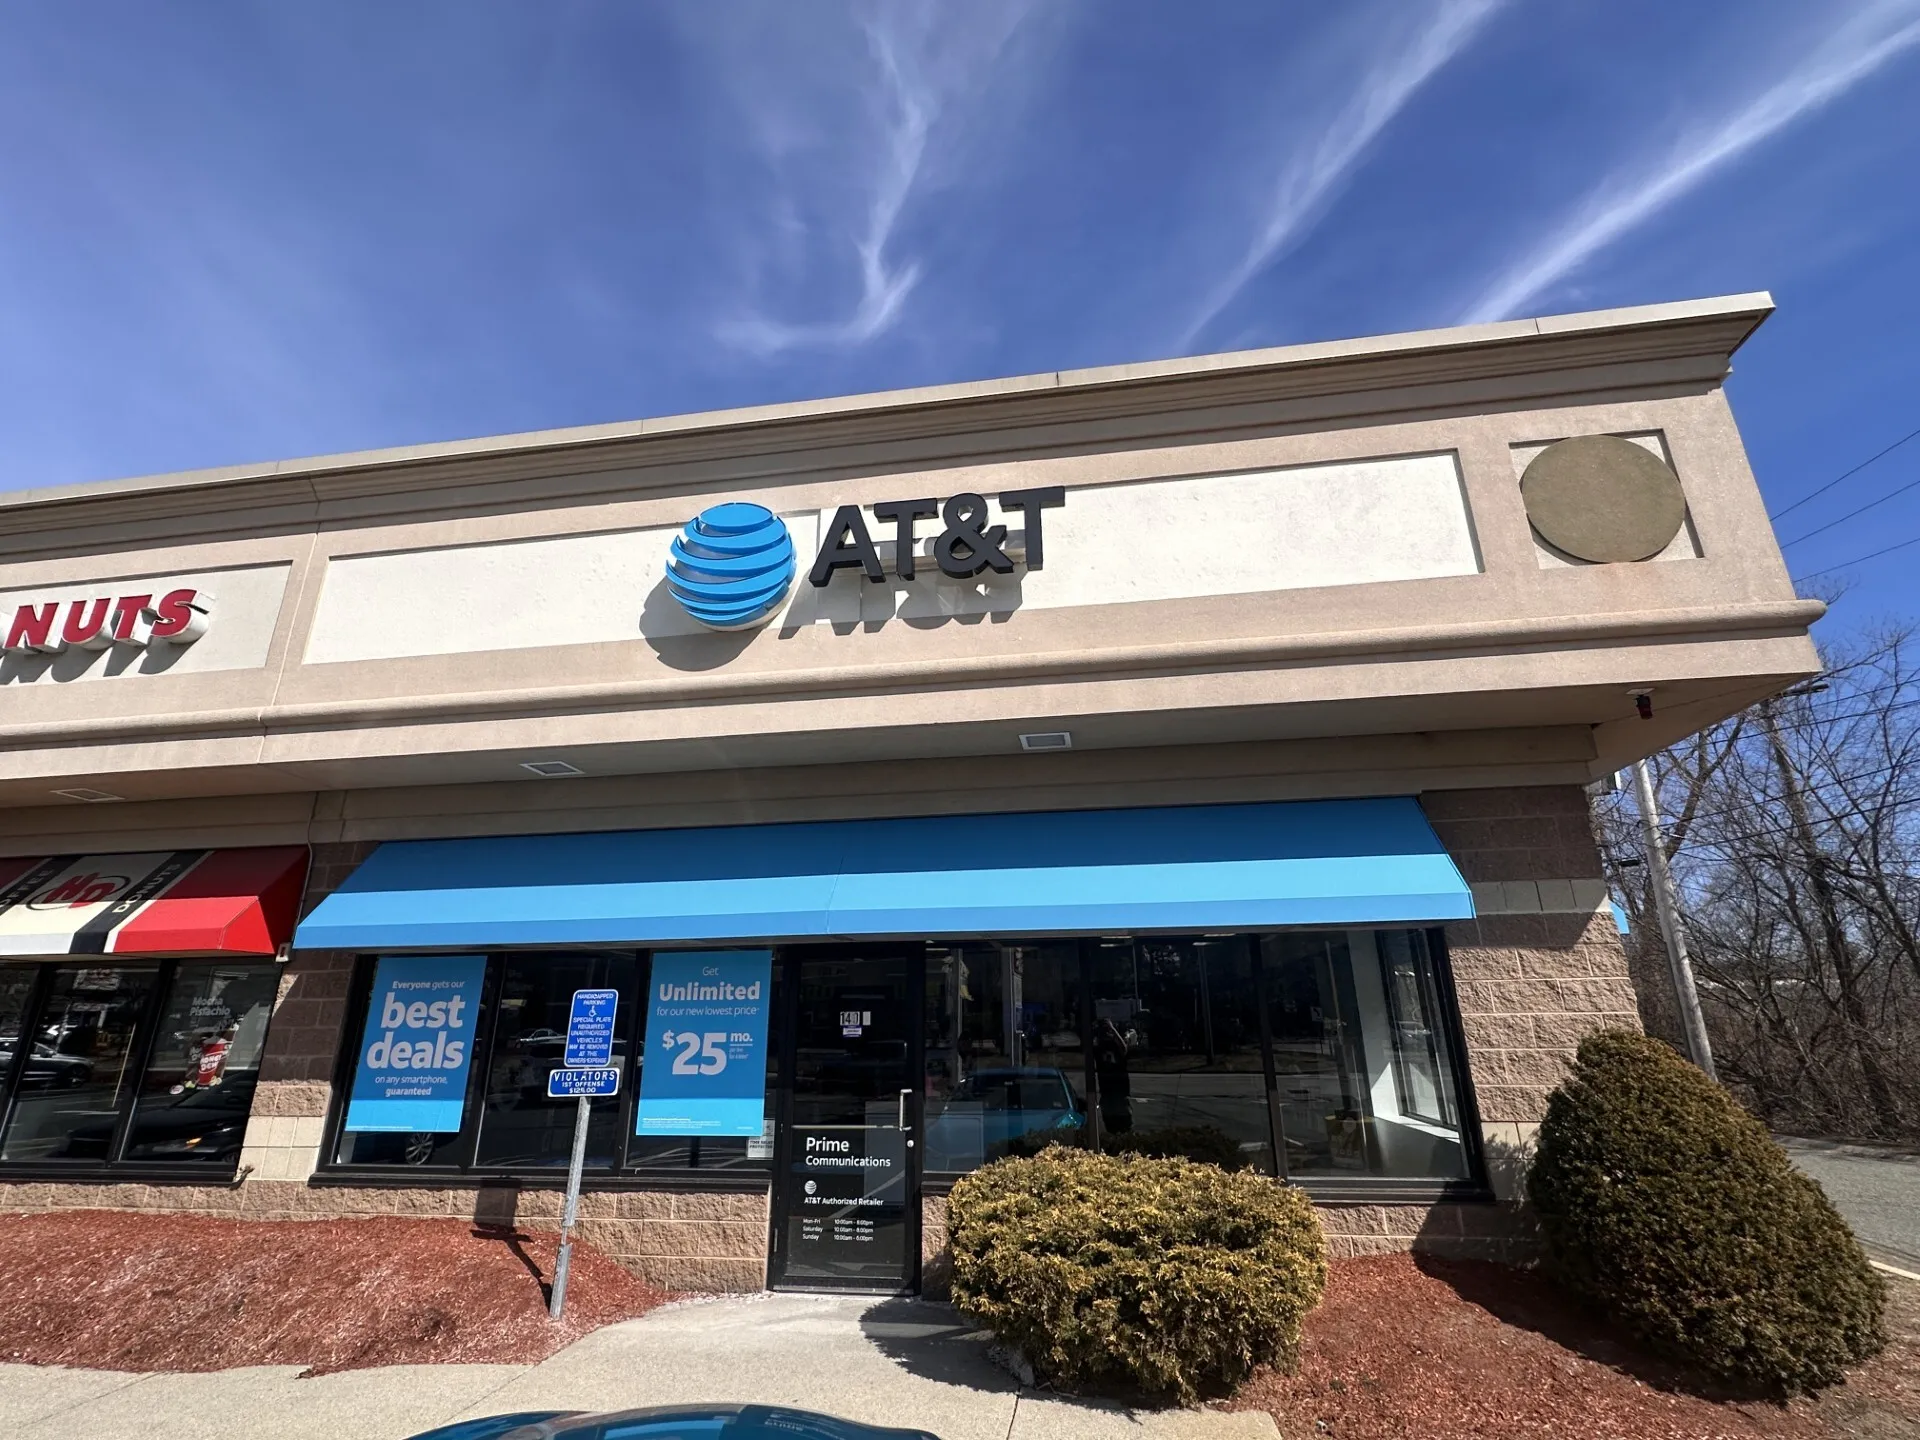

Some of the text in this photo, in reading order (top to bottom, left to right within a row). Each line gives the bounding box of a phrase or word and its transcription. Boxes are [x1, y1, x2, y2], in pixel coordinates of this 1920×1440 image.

[808, 486, 1066, 588] AT&T
[3, 588, 198, 648] NUTS
[111, 863, 181, 912] DONUTS
[702, 966, 719, 976] Get
[392, 980, 431, 990] Everyone
[432, 981, 449, 991] gets
[660, 981, 761, 1001] Unlimited
[189, 1005, 231, 1016] Pistachio
[381, 992, 465, 1029] best
[656, 1006, 668, 1016] for
[669, 1007, 685, 1016] our
[685, 1007, 704, 1016] new
[704, 1006, 733, 1016] lowest
[730, 1032, 753, 1042] mo.
[366, 1031, 465, 1069] deals
[386, 1076, 400, 1085] any
[554, 1071, 615, 1082] VIOLATORS
[385, 1087, 432, 1097] guaranteed
[805, 1136, 850, 1152] Prime
[805, 1155, 891, 1167] Communications
[822, 1197, 857, 1205] Authorized
[858, 1198, 884, 1206] Retailer
